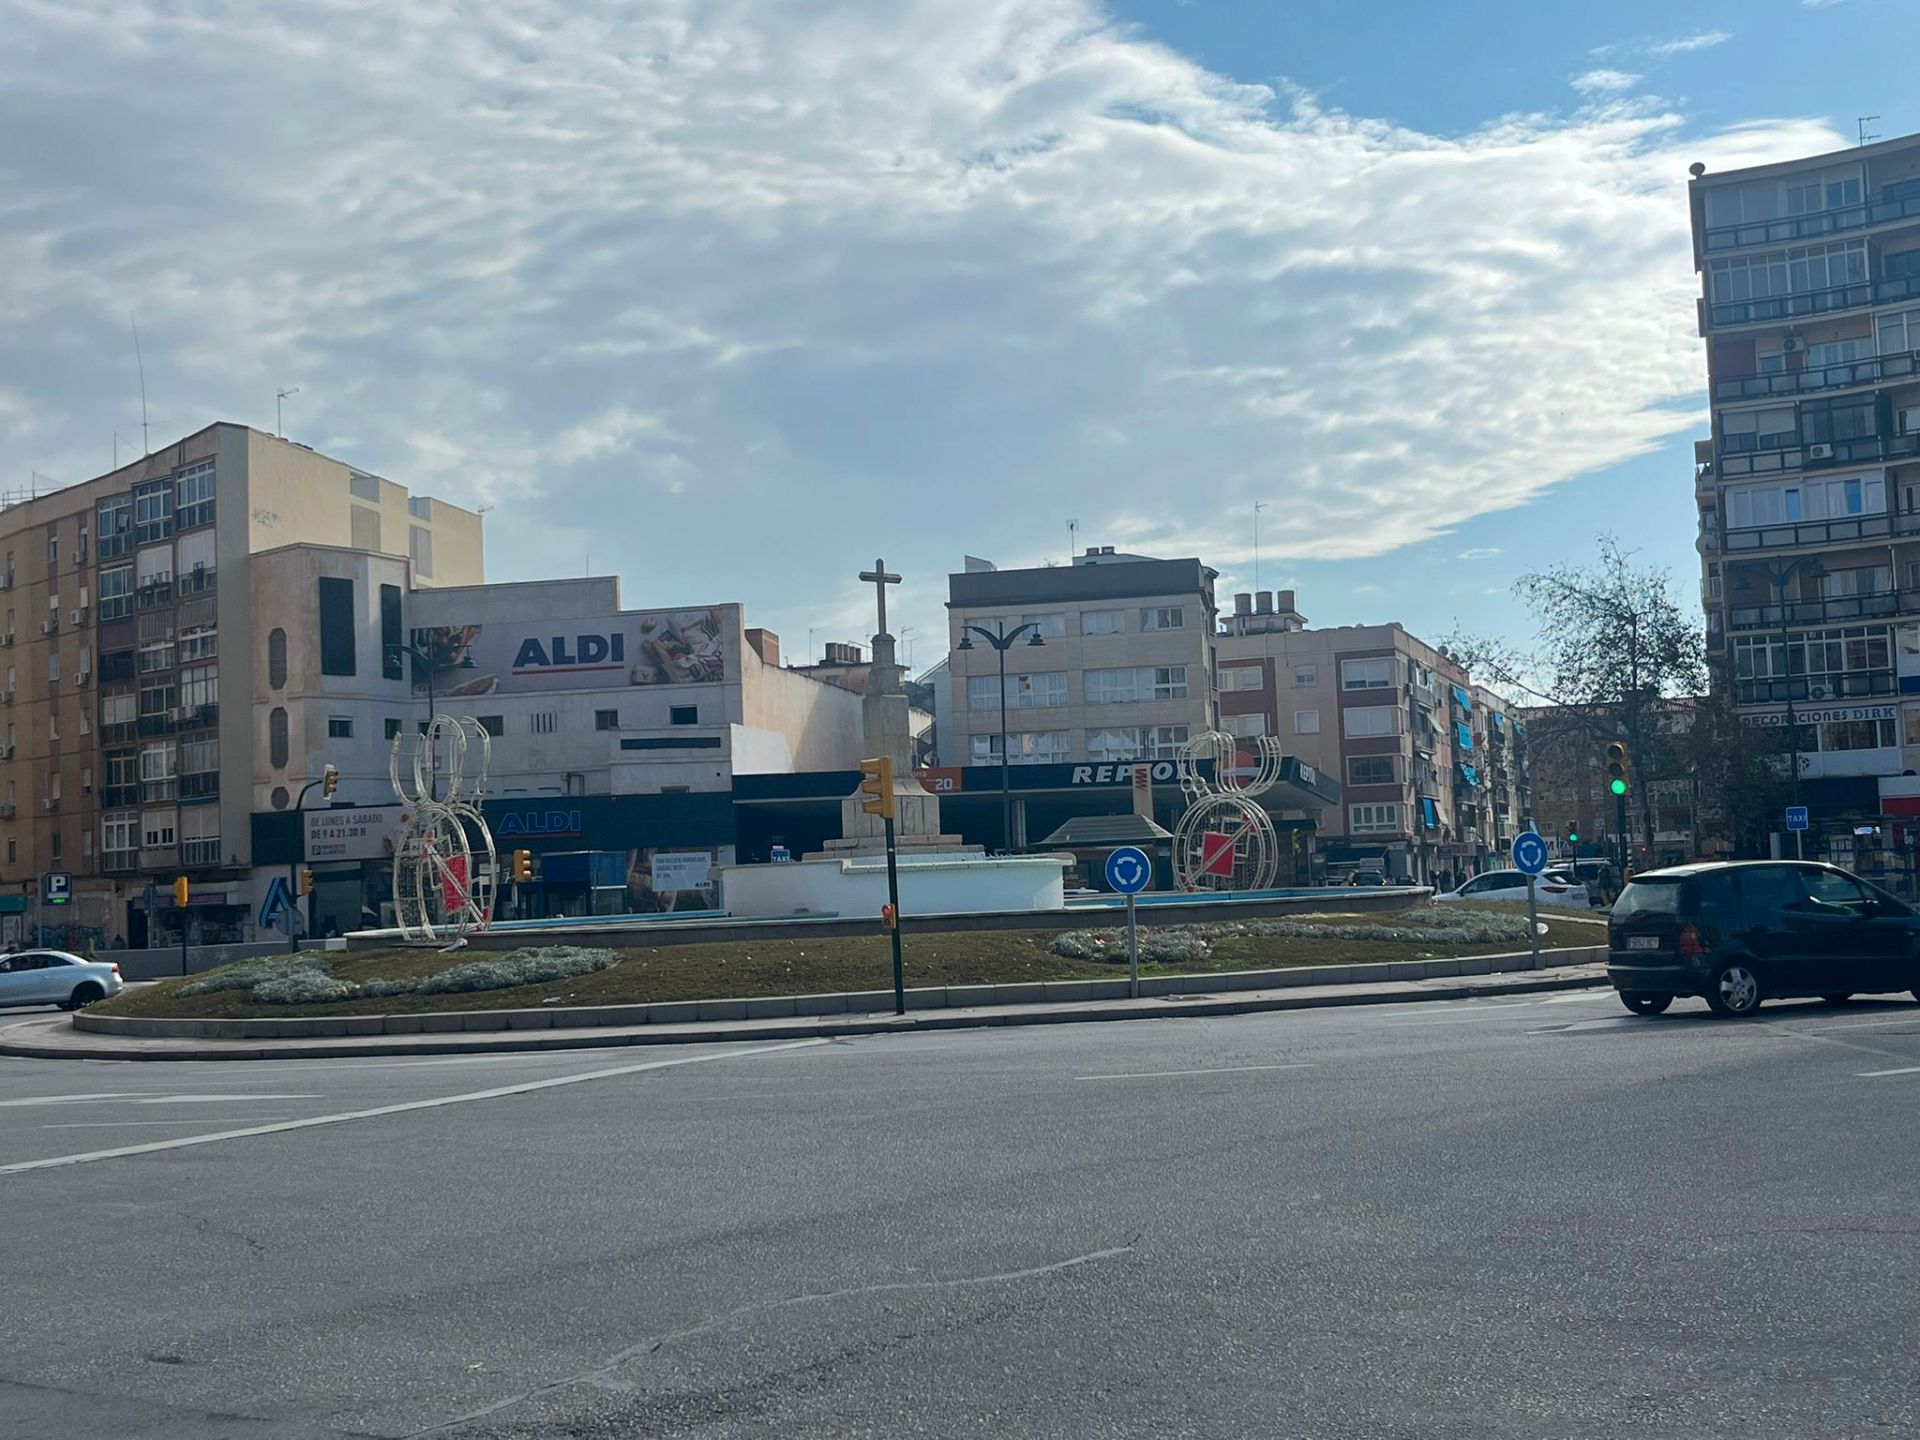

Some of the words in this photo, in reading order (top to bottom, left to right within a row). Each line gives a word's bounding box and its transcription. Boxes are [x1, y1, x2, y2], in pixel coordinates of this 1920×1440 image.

[512, 632, 624, 668] ALDI
[1853, 707, 1894, 720] DIRK
[1071, 762, 1188, 784] REPOL
[935, 778, 953, 790] 20
[311, 817, 320, 827] DE
[322, 815, 344, 826] LUNES
[346, 815, 352, 824] A
[496, 810, 581, 834] ALDI
[311, 829, 321, 840] DE
[322, 829, 328, 838] 9
[329, 829, 335, 838] A
[337, 827, 359, 838] 21.30
[360, 827, 367, 837] H
[50, 876, 66, 892] P
